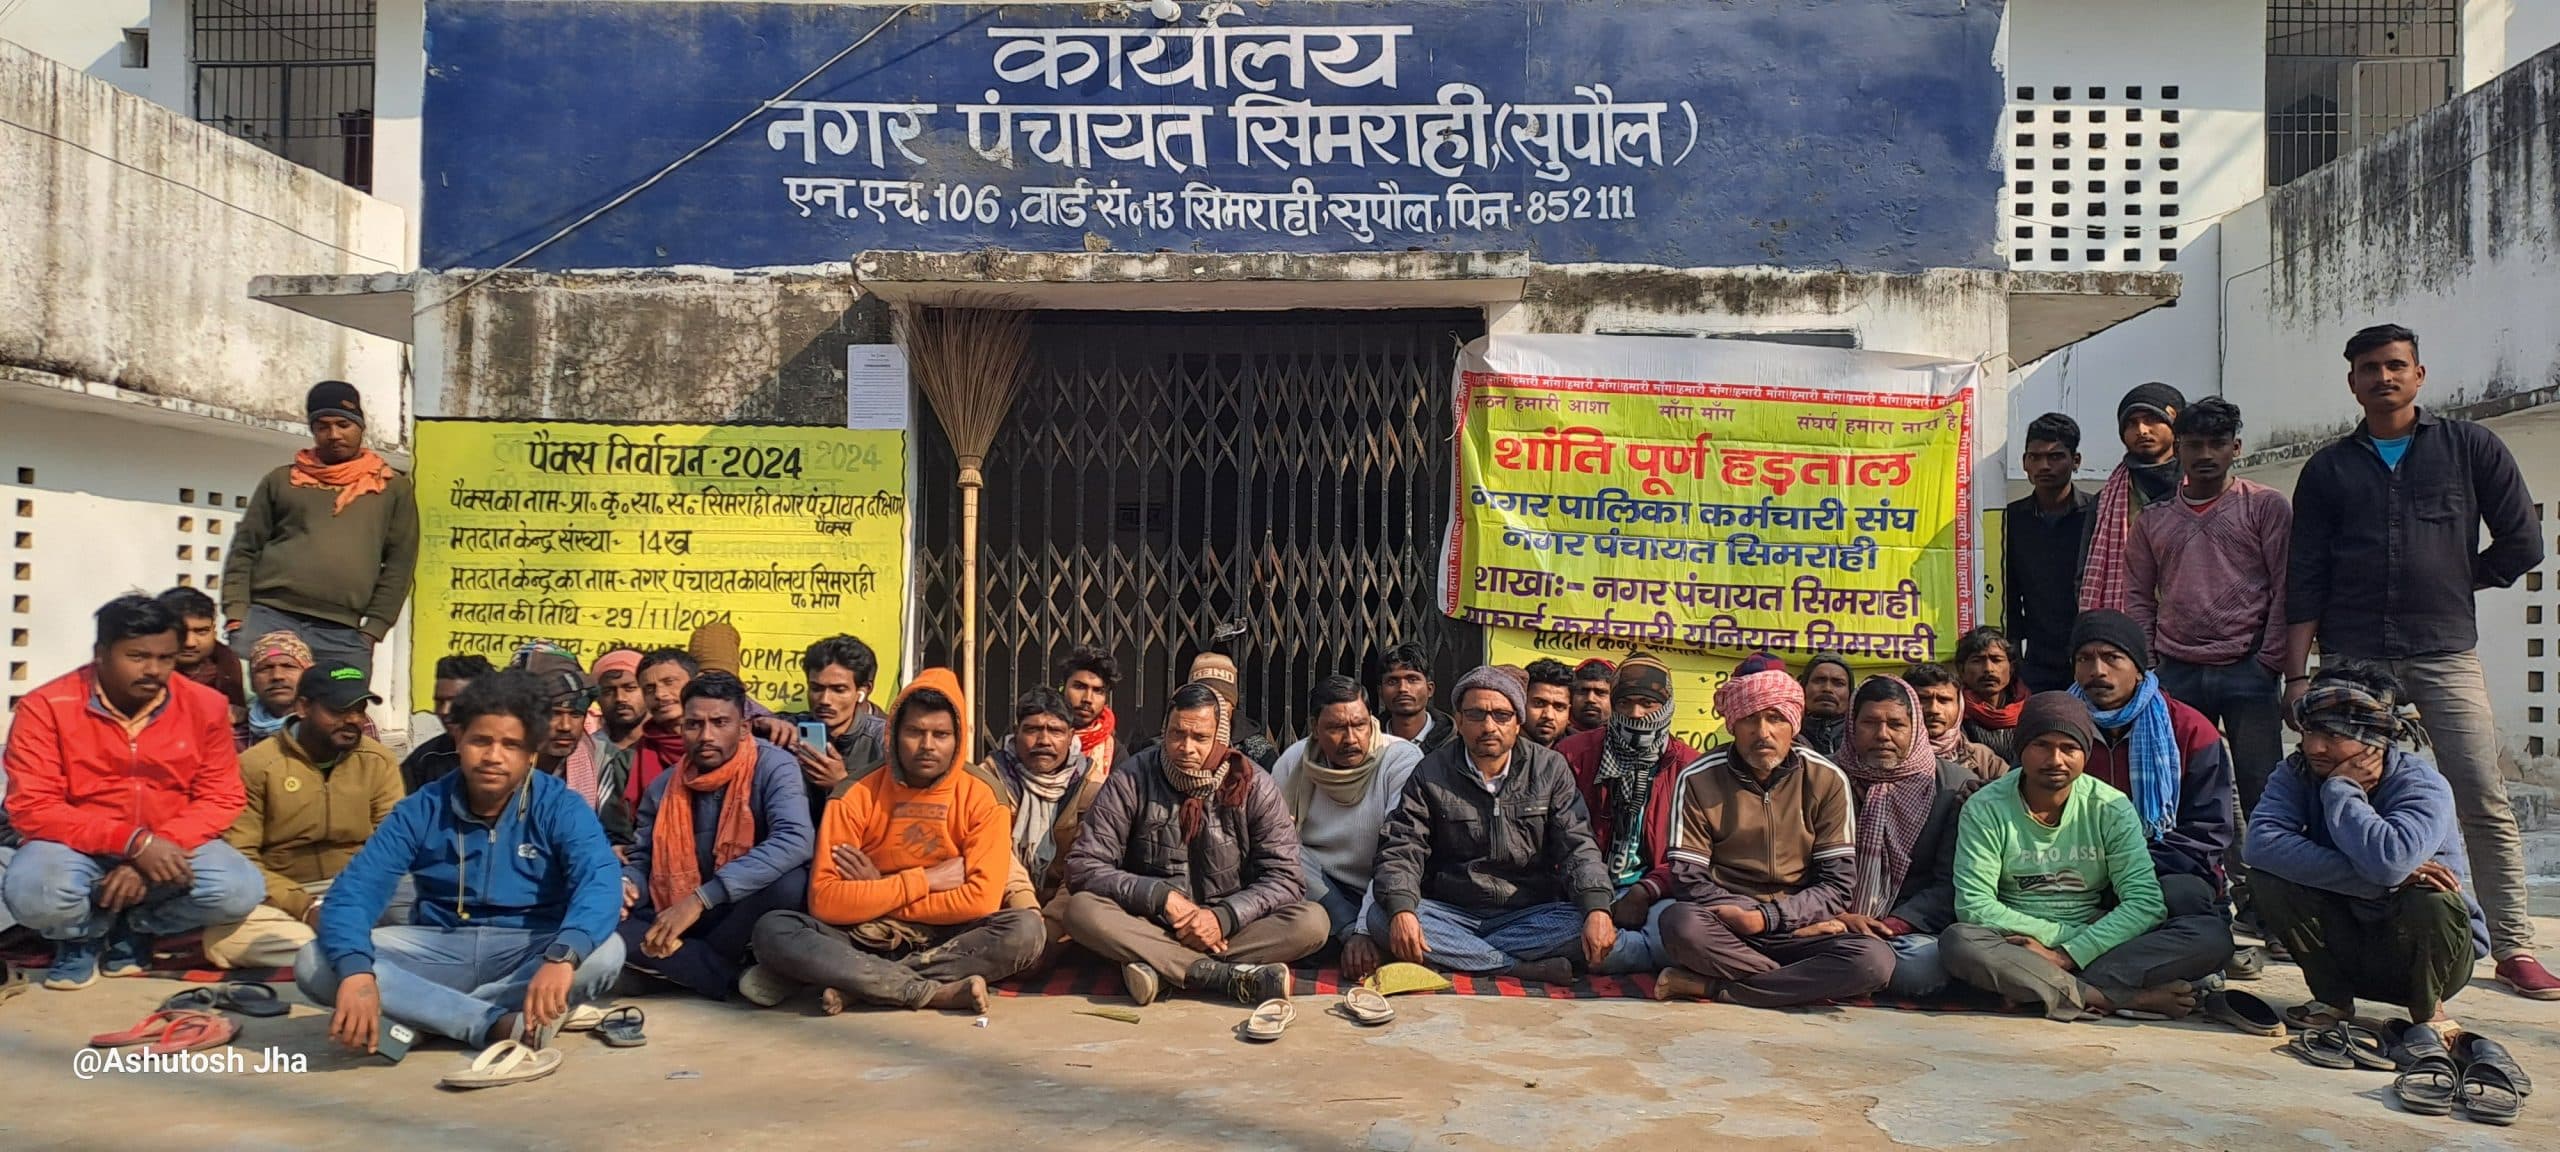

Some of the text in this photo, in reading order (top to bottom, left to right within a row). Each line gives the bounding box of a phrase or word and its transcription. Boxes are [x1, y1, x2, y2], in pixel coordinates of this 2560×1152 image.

[987, 2, 1413, 91] कार्यालय
[764, 100, 937, 168] नगर
[956, 90, 1213, 174] पंचायत
[1514, 393, 1561, 412] हमारी
[1568, 399, 1610, 415] आशा
[1658, 398, 1736, 423] माँग माँग
[1797, 408, 1959, 436] संघर्ष हमारा नारा है
[524, 429, 604, 475] पैक्स
[1494, 426, 1916, 497] शांति पूर्ण हड़ताल
[1472, 485, 1919, 533] नगर पालिका कर्मचारी संघ
[450, 526, 512, 552] मतदान
[1503, 526, 1879, 573] नगर पंचायत सिमराही
[451, 566, 512, 592] मतदान
[555, 569, 583, 590] का
[672, 563, 738, 593] पंचायत
[809, 563, 877, 600] सिमराही
[1593, 577, 1671, 607] नगर
[1675, 572, 1785, 616] पंचायत
[1792, 575, 1921, 619] सिमराही
[450, 602, 506, 624] मतदान
[508, 598, 534, 625] की
[448, 631, 509, 653] मतदान
[1805, 619, 1937, 664] सिमराही
